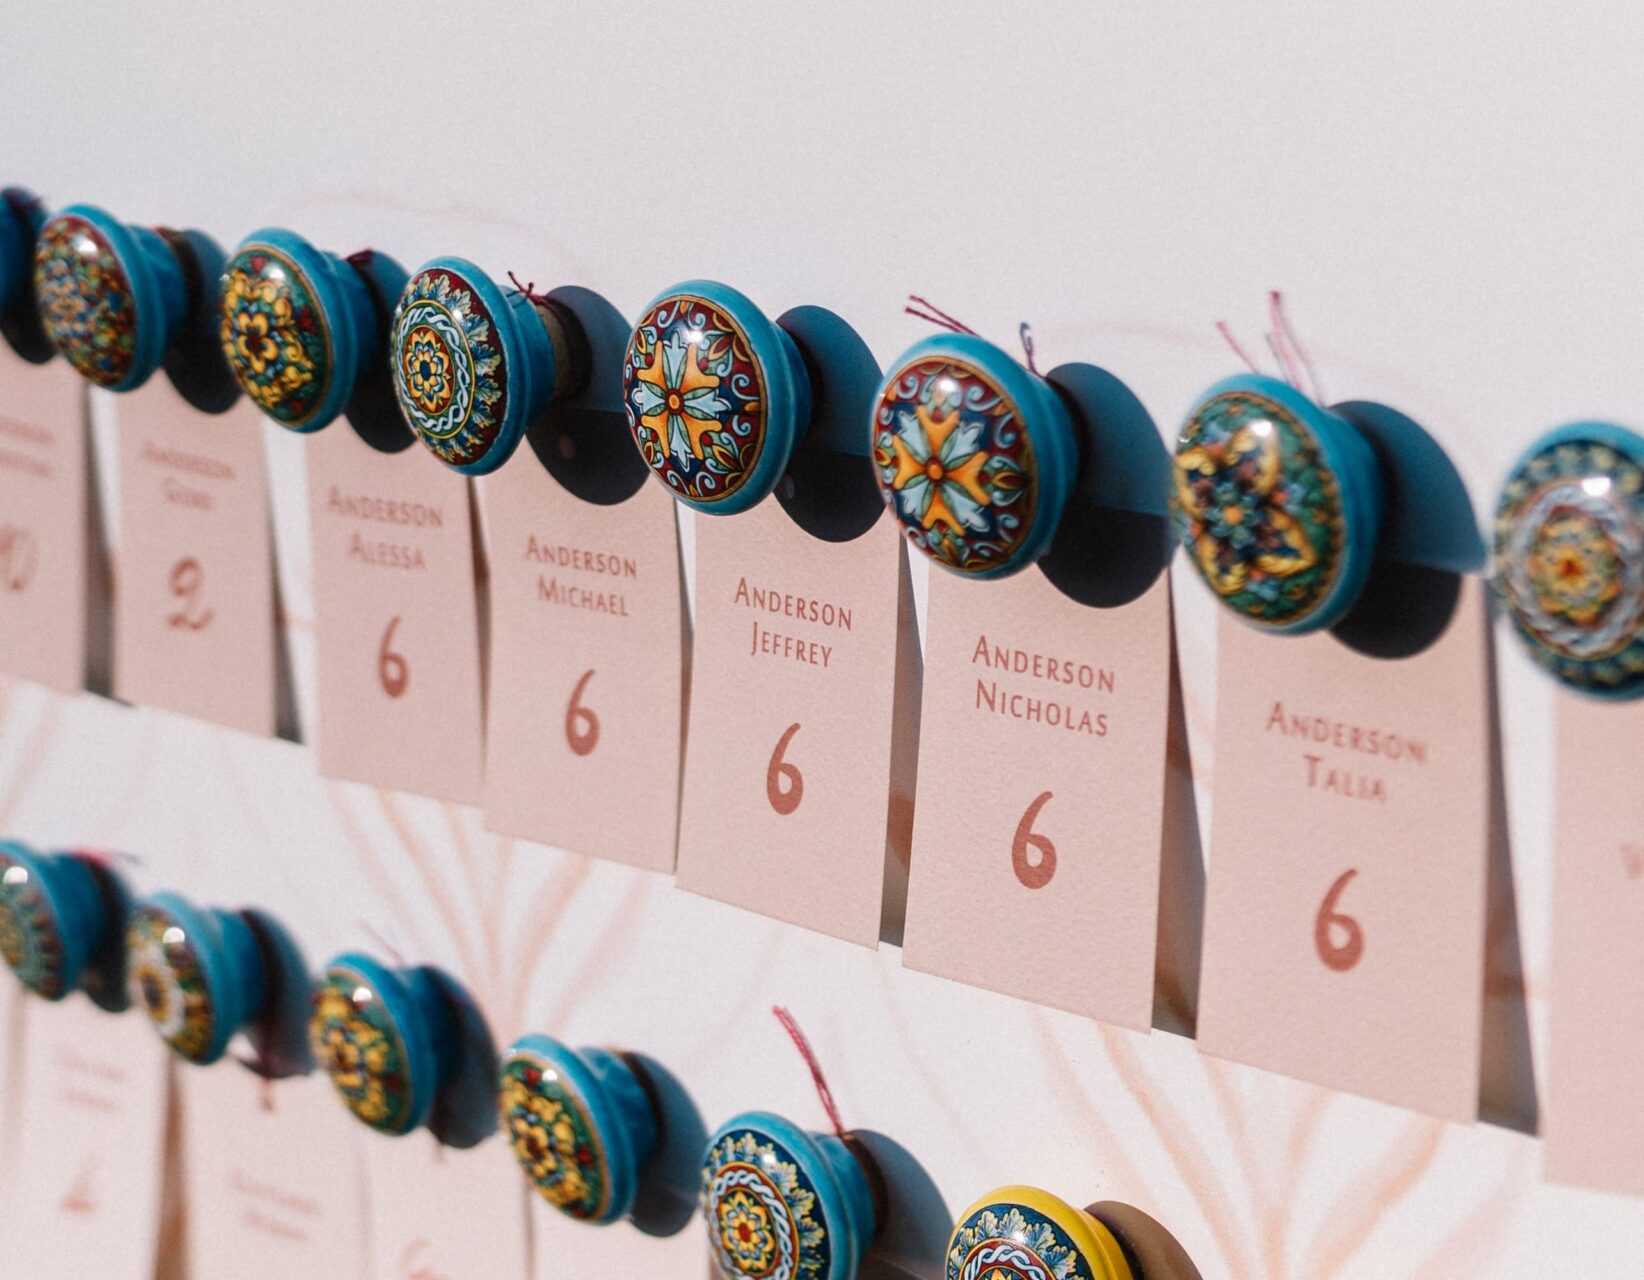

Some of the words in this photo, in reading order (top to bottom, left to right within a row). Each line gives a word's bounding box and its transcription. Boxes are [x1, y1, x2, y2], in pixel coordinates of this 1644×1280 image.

[328, 486, 443, 527] ANDERSON
[350, 533, 426, 571] ALESSA
[526, 535, 637, 578] ANDERSON
[167, 556, 215, 632] 2
[537, 575, 629, 617] MICHAEL
[734, 577, 853, 631] ANDERSON
[378, 615, 410, 699] 6
[751, 622, 832, 668] JEFFREY
[971, 634, 1115, 693] ANDERSON
[565, 668, 600, 757] 6
[976, 679, 1108, 737] NICHOLAS
[1267, 701, 1425, 765] ANDERSON
[766, 723, 804, 815] 6
[1303, 754, 1387, 803] TALIA
[1011, 791, 1058, 890] 6
[1314, 868, 1365, 973] 6
